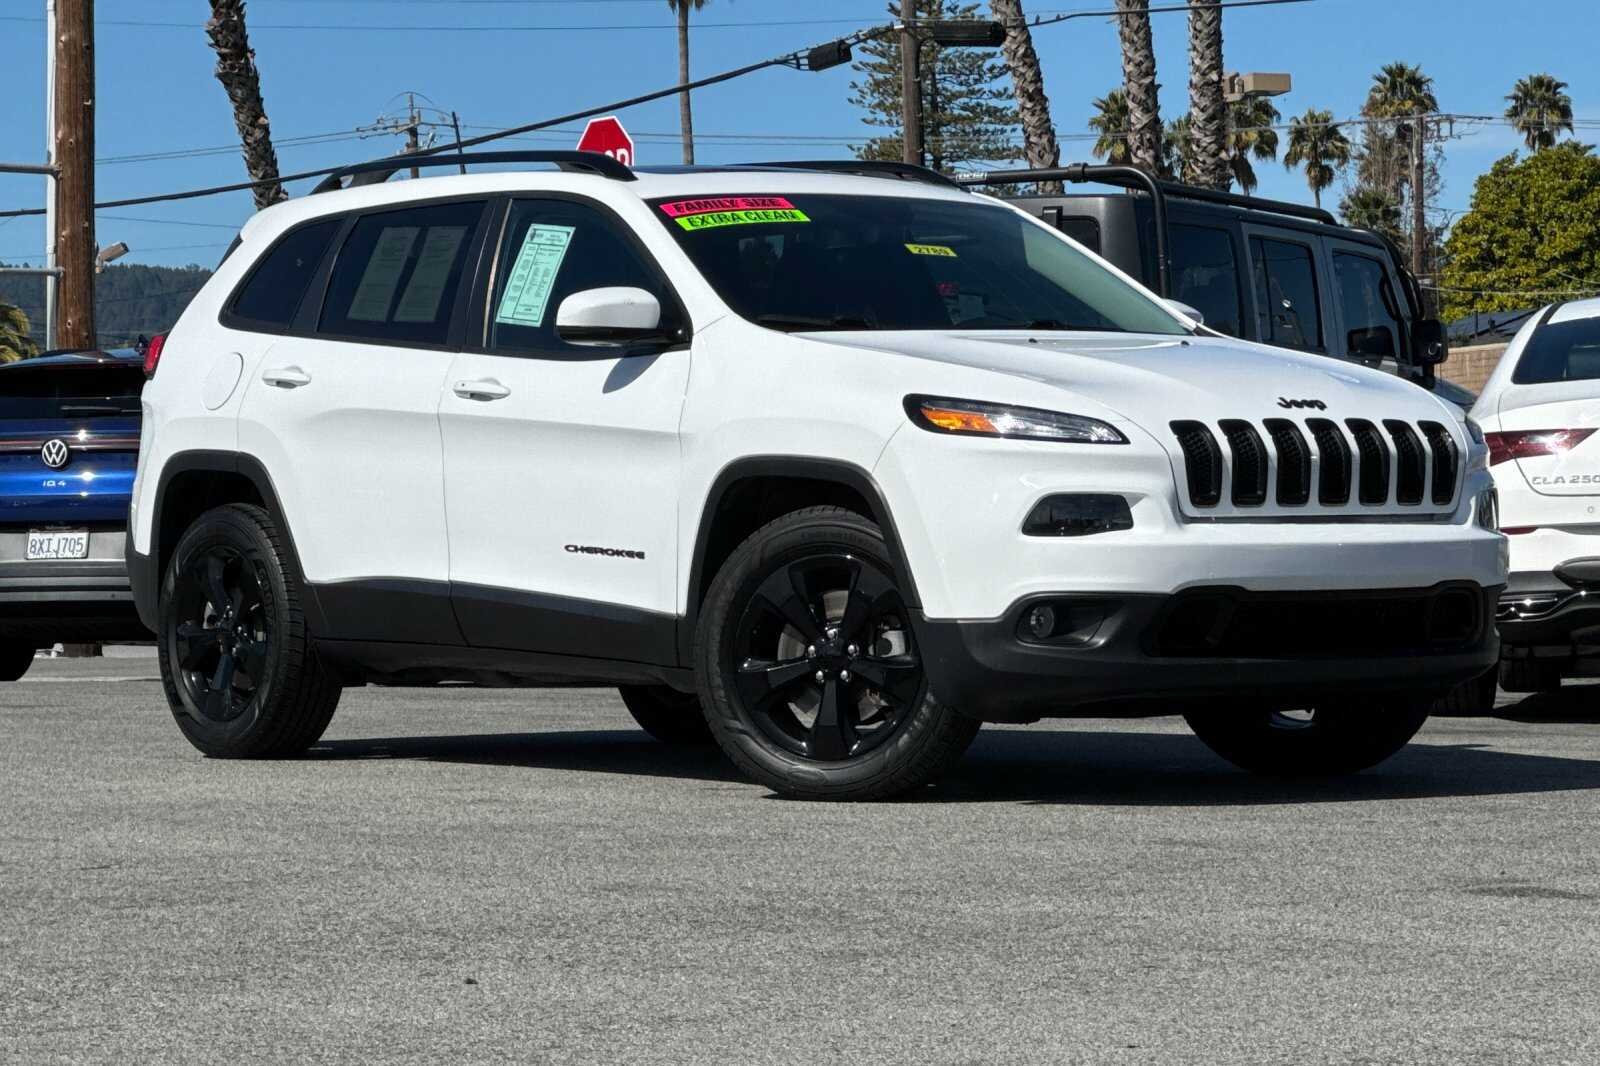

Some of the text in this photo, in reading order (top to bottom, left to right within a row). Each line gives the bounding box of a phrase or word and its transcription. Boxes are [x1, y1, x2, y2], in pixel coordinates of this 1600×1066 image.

[673, 198, 783, 213] FAMILY SIZE
[687, 210, 797, 227] EXTRA CLEAN
[1277, 396, 1328, 411] Jeep
[1532, 475, 1600, 485] CLA 250
[29, 537, 84, 554] 8XIJ705
[564, 544, 645, 560] CHEROKEE
